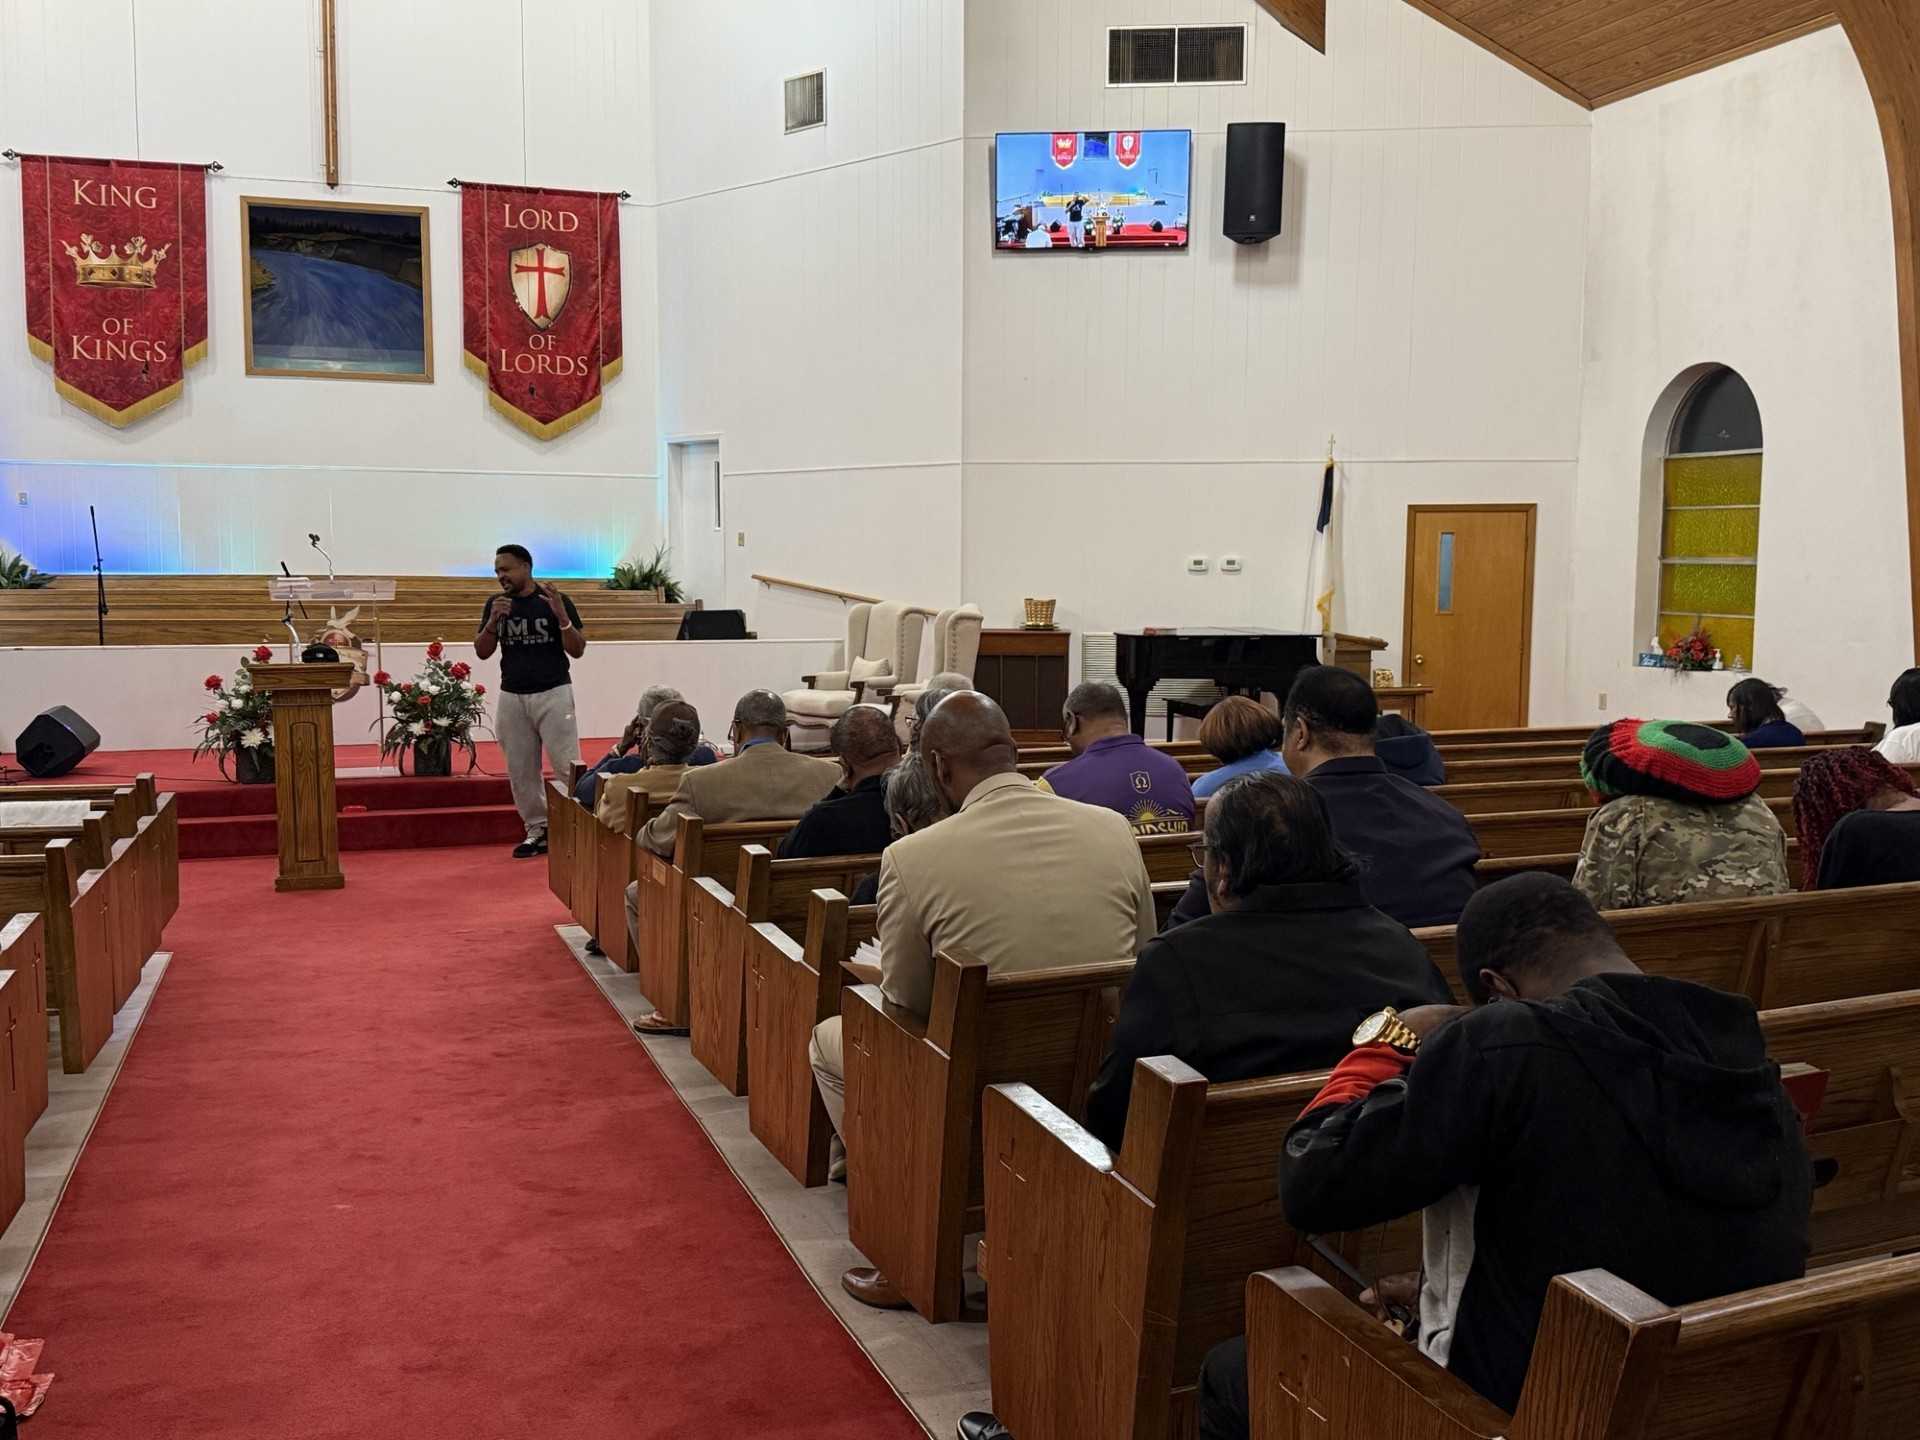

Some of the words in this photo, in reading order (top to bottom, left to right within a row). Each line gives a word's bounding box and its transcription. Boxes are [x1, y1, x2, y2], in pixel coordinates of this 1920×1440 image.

[72, 179, 157, 209] KING
[503, 203, 579, 232] LORD
[102, 317, 134, 336] OF
[71, 335, 167, 362] KINGS
[529, 334, 557, 351] OF
[500, 349, 589, 376] LORDS
